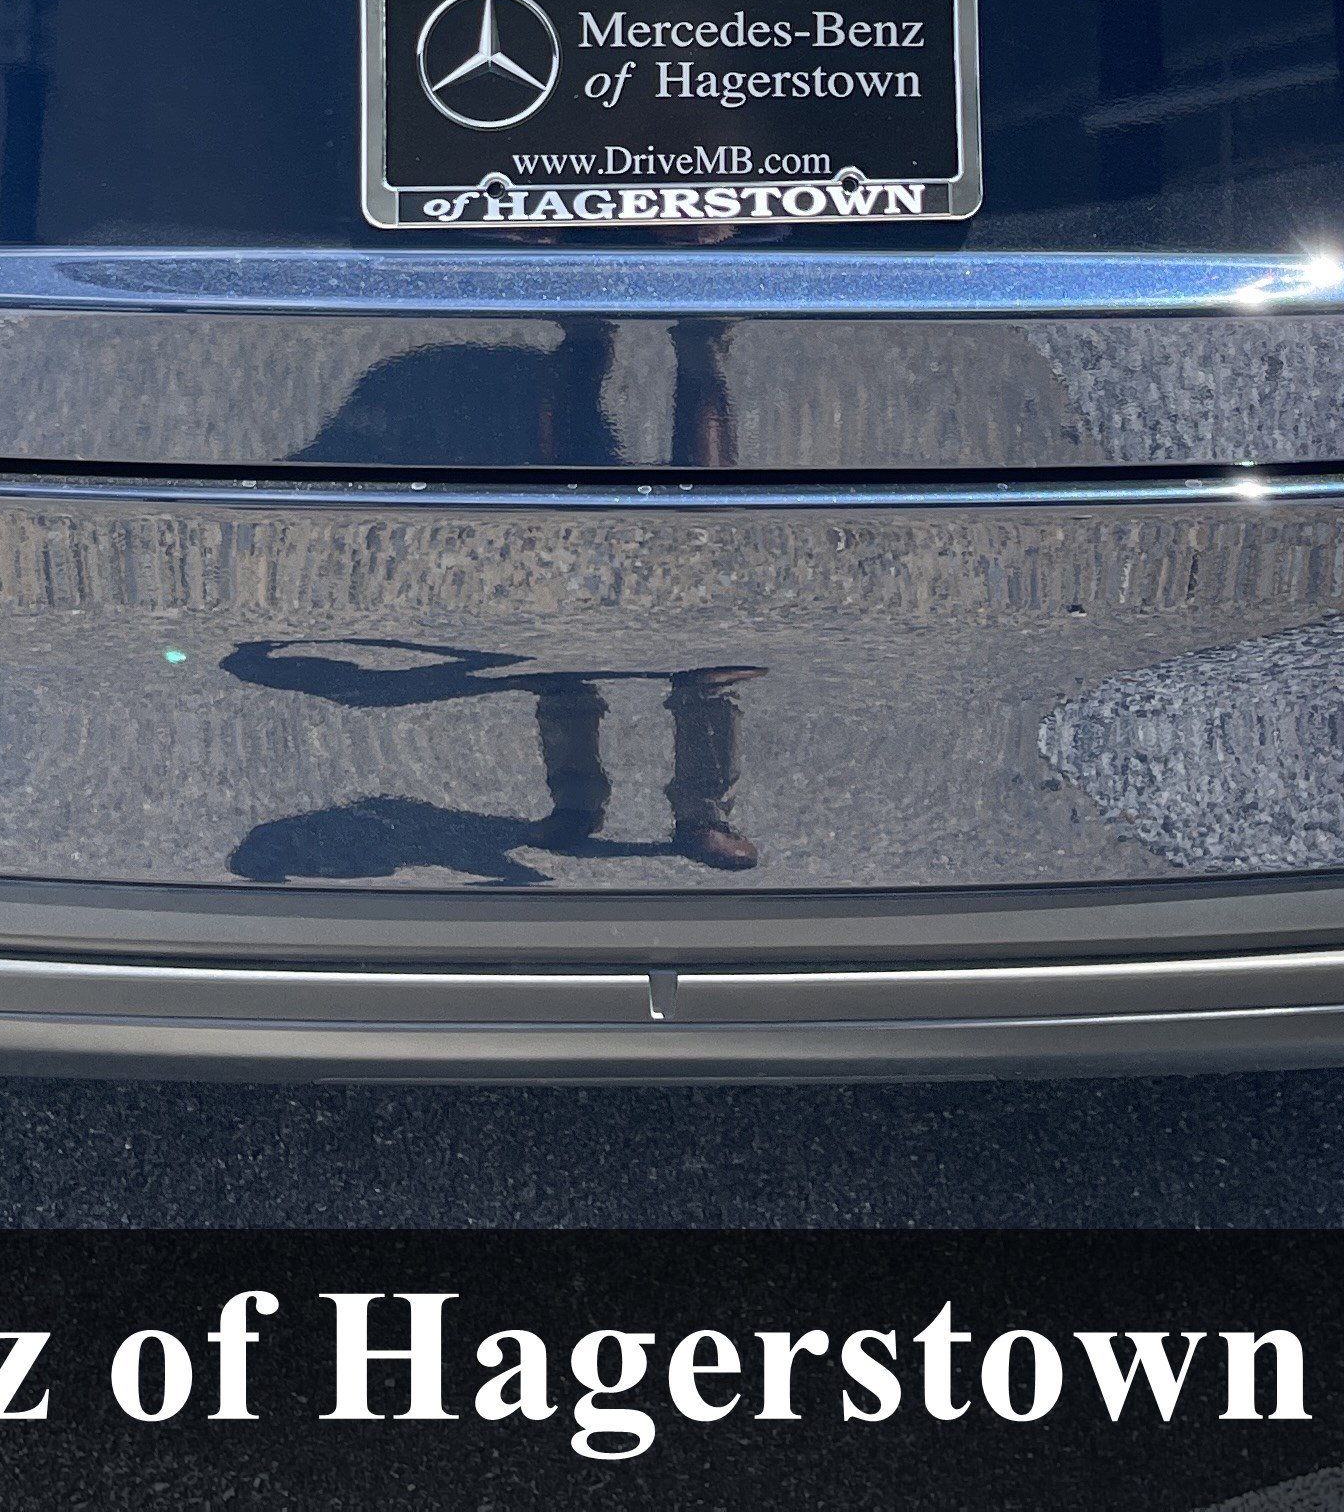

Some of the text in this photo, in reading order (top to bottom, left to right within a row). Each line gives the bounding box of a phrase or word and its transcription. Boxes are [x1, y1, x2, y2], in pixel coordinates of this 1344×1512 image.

[577, 10, 925, 49] Mercedes-Benz
[584, 61, 923, 108] of Hagerstown
[511, 145, 832, 175] www.DriveMB.com
[423, 183, 927, 223] of HAGERSTOWN
